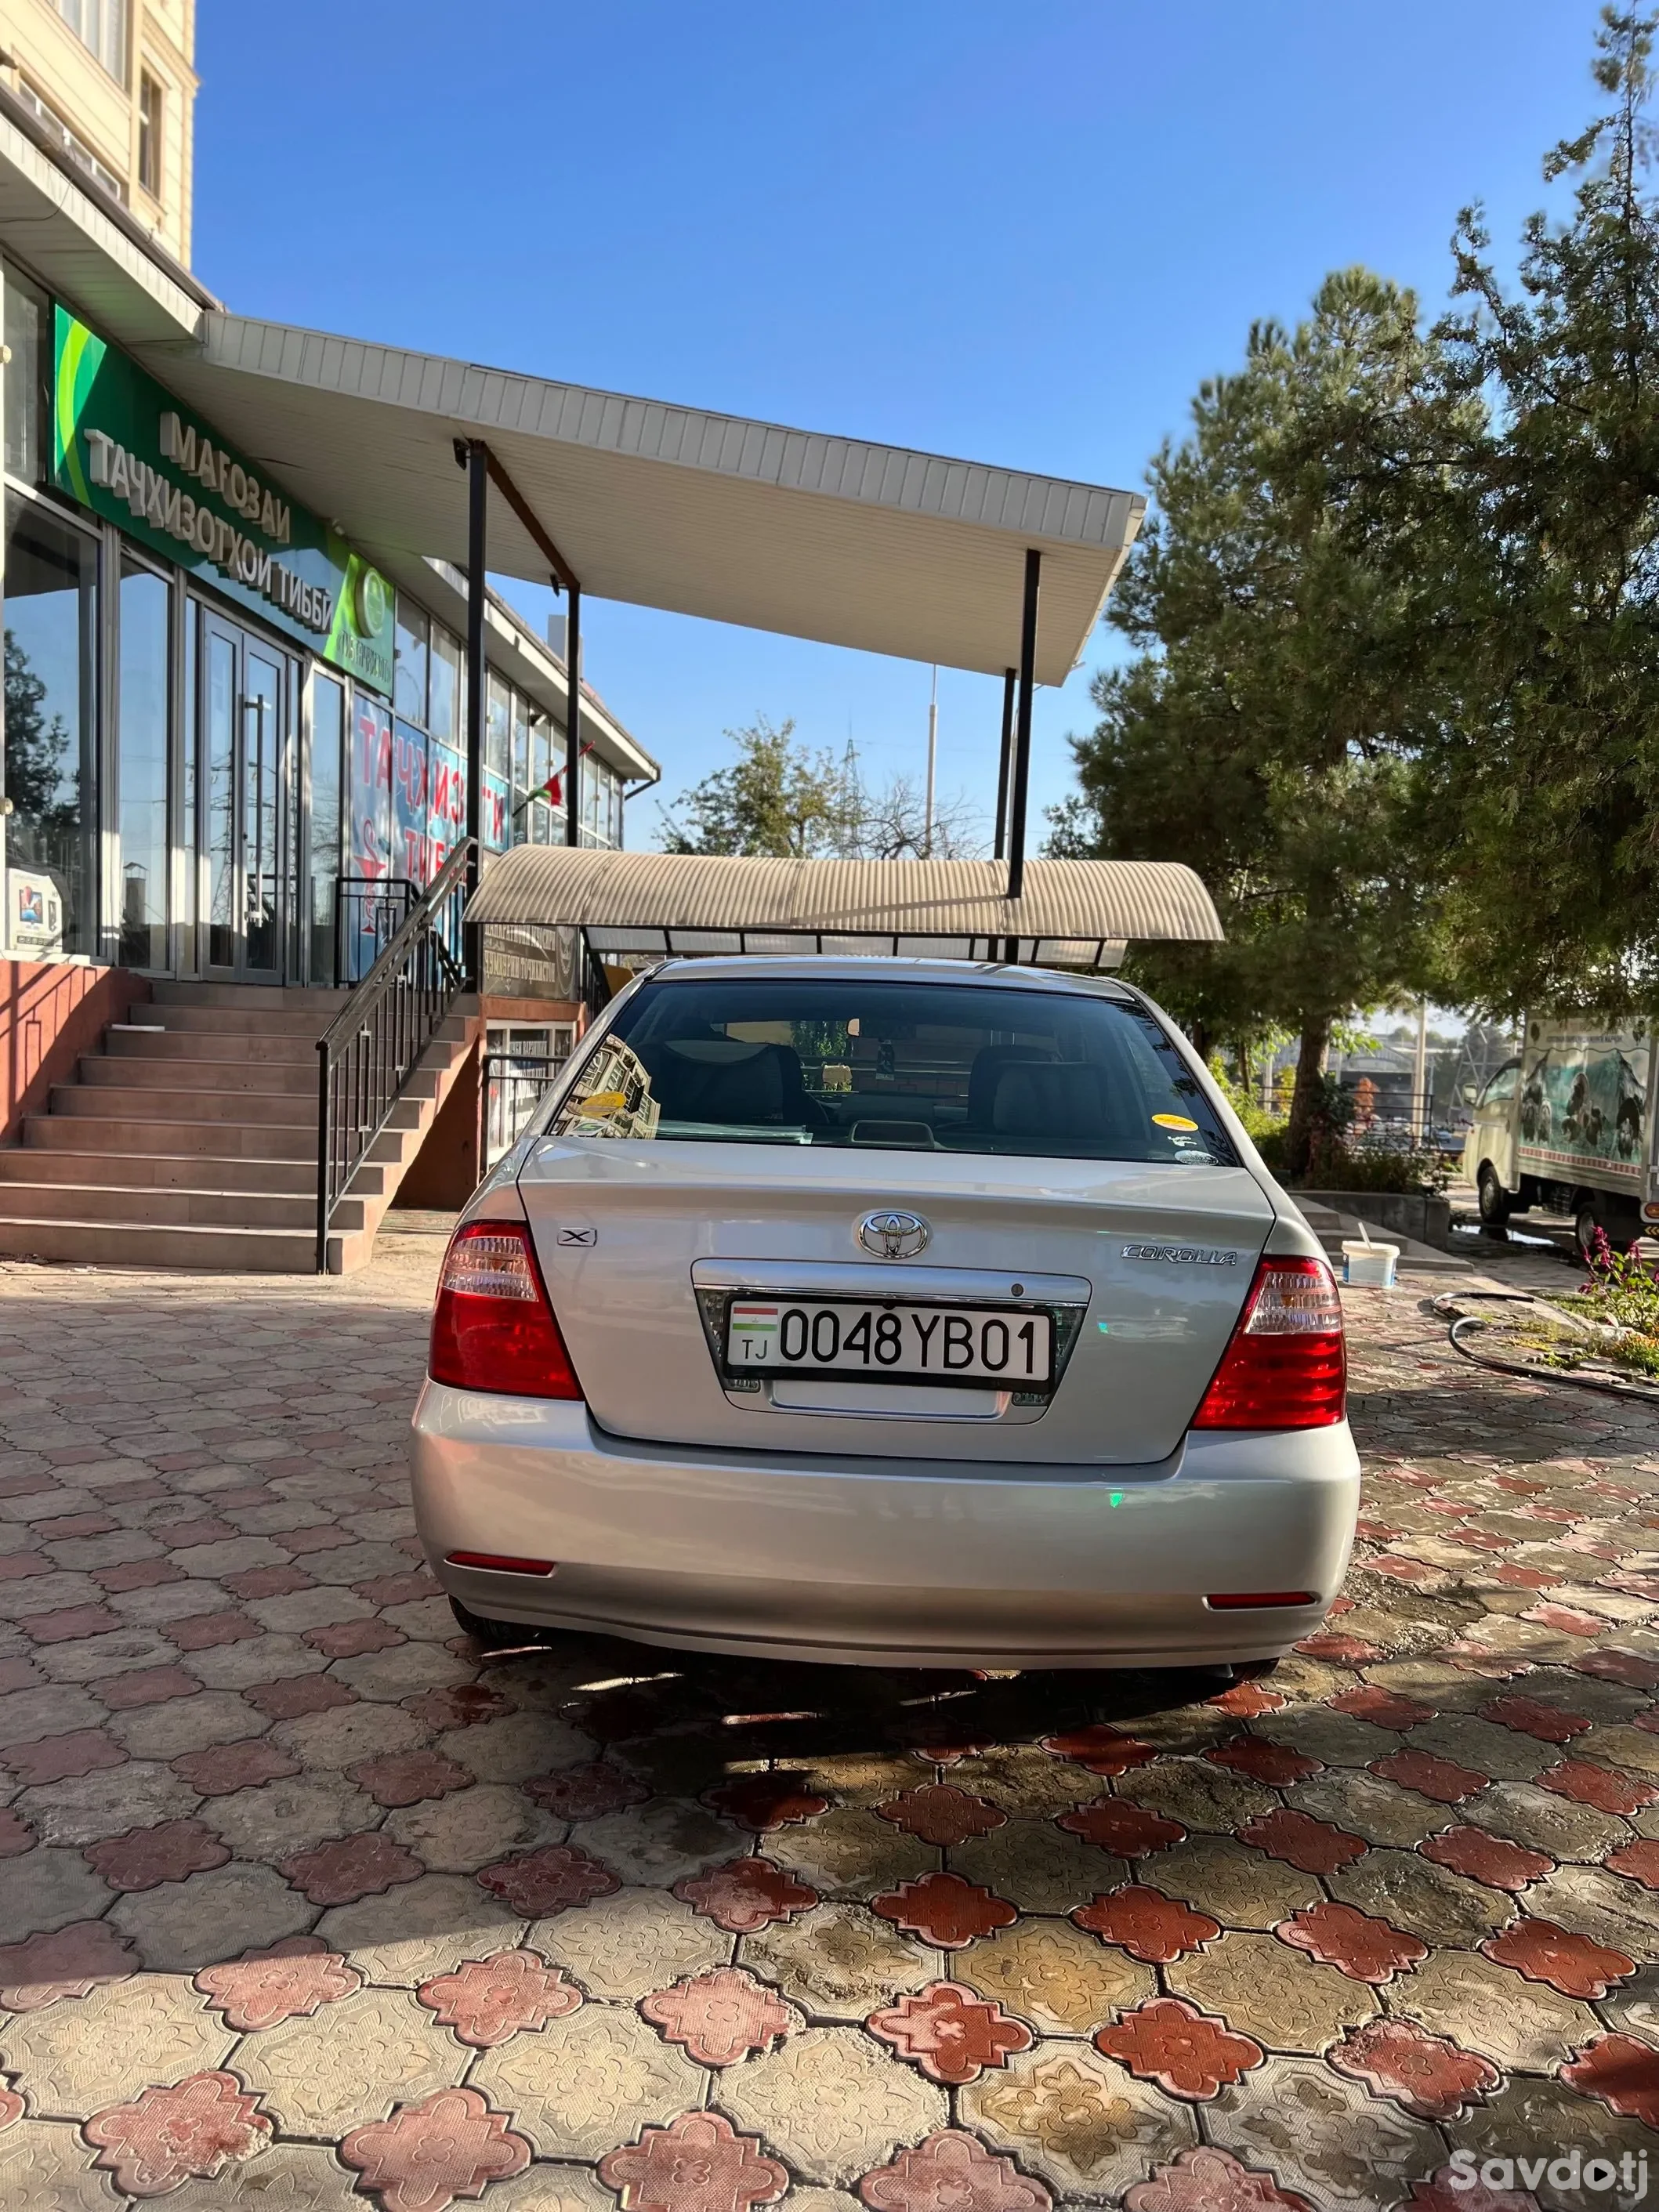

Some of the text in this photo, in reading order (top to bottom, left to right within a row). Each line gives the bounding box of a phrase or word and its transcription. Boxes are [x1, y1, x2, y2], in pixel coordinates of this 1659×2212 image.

[562, 1229, 591, 1244] X
[1121, 1244, 1238, 1265] COROLLA
[742, 1339, 768, 1360] TJ
[780, 1309, 1034, 1374] 0048YB01
